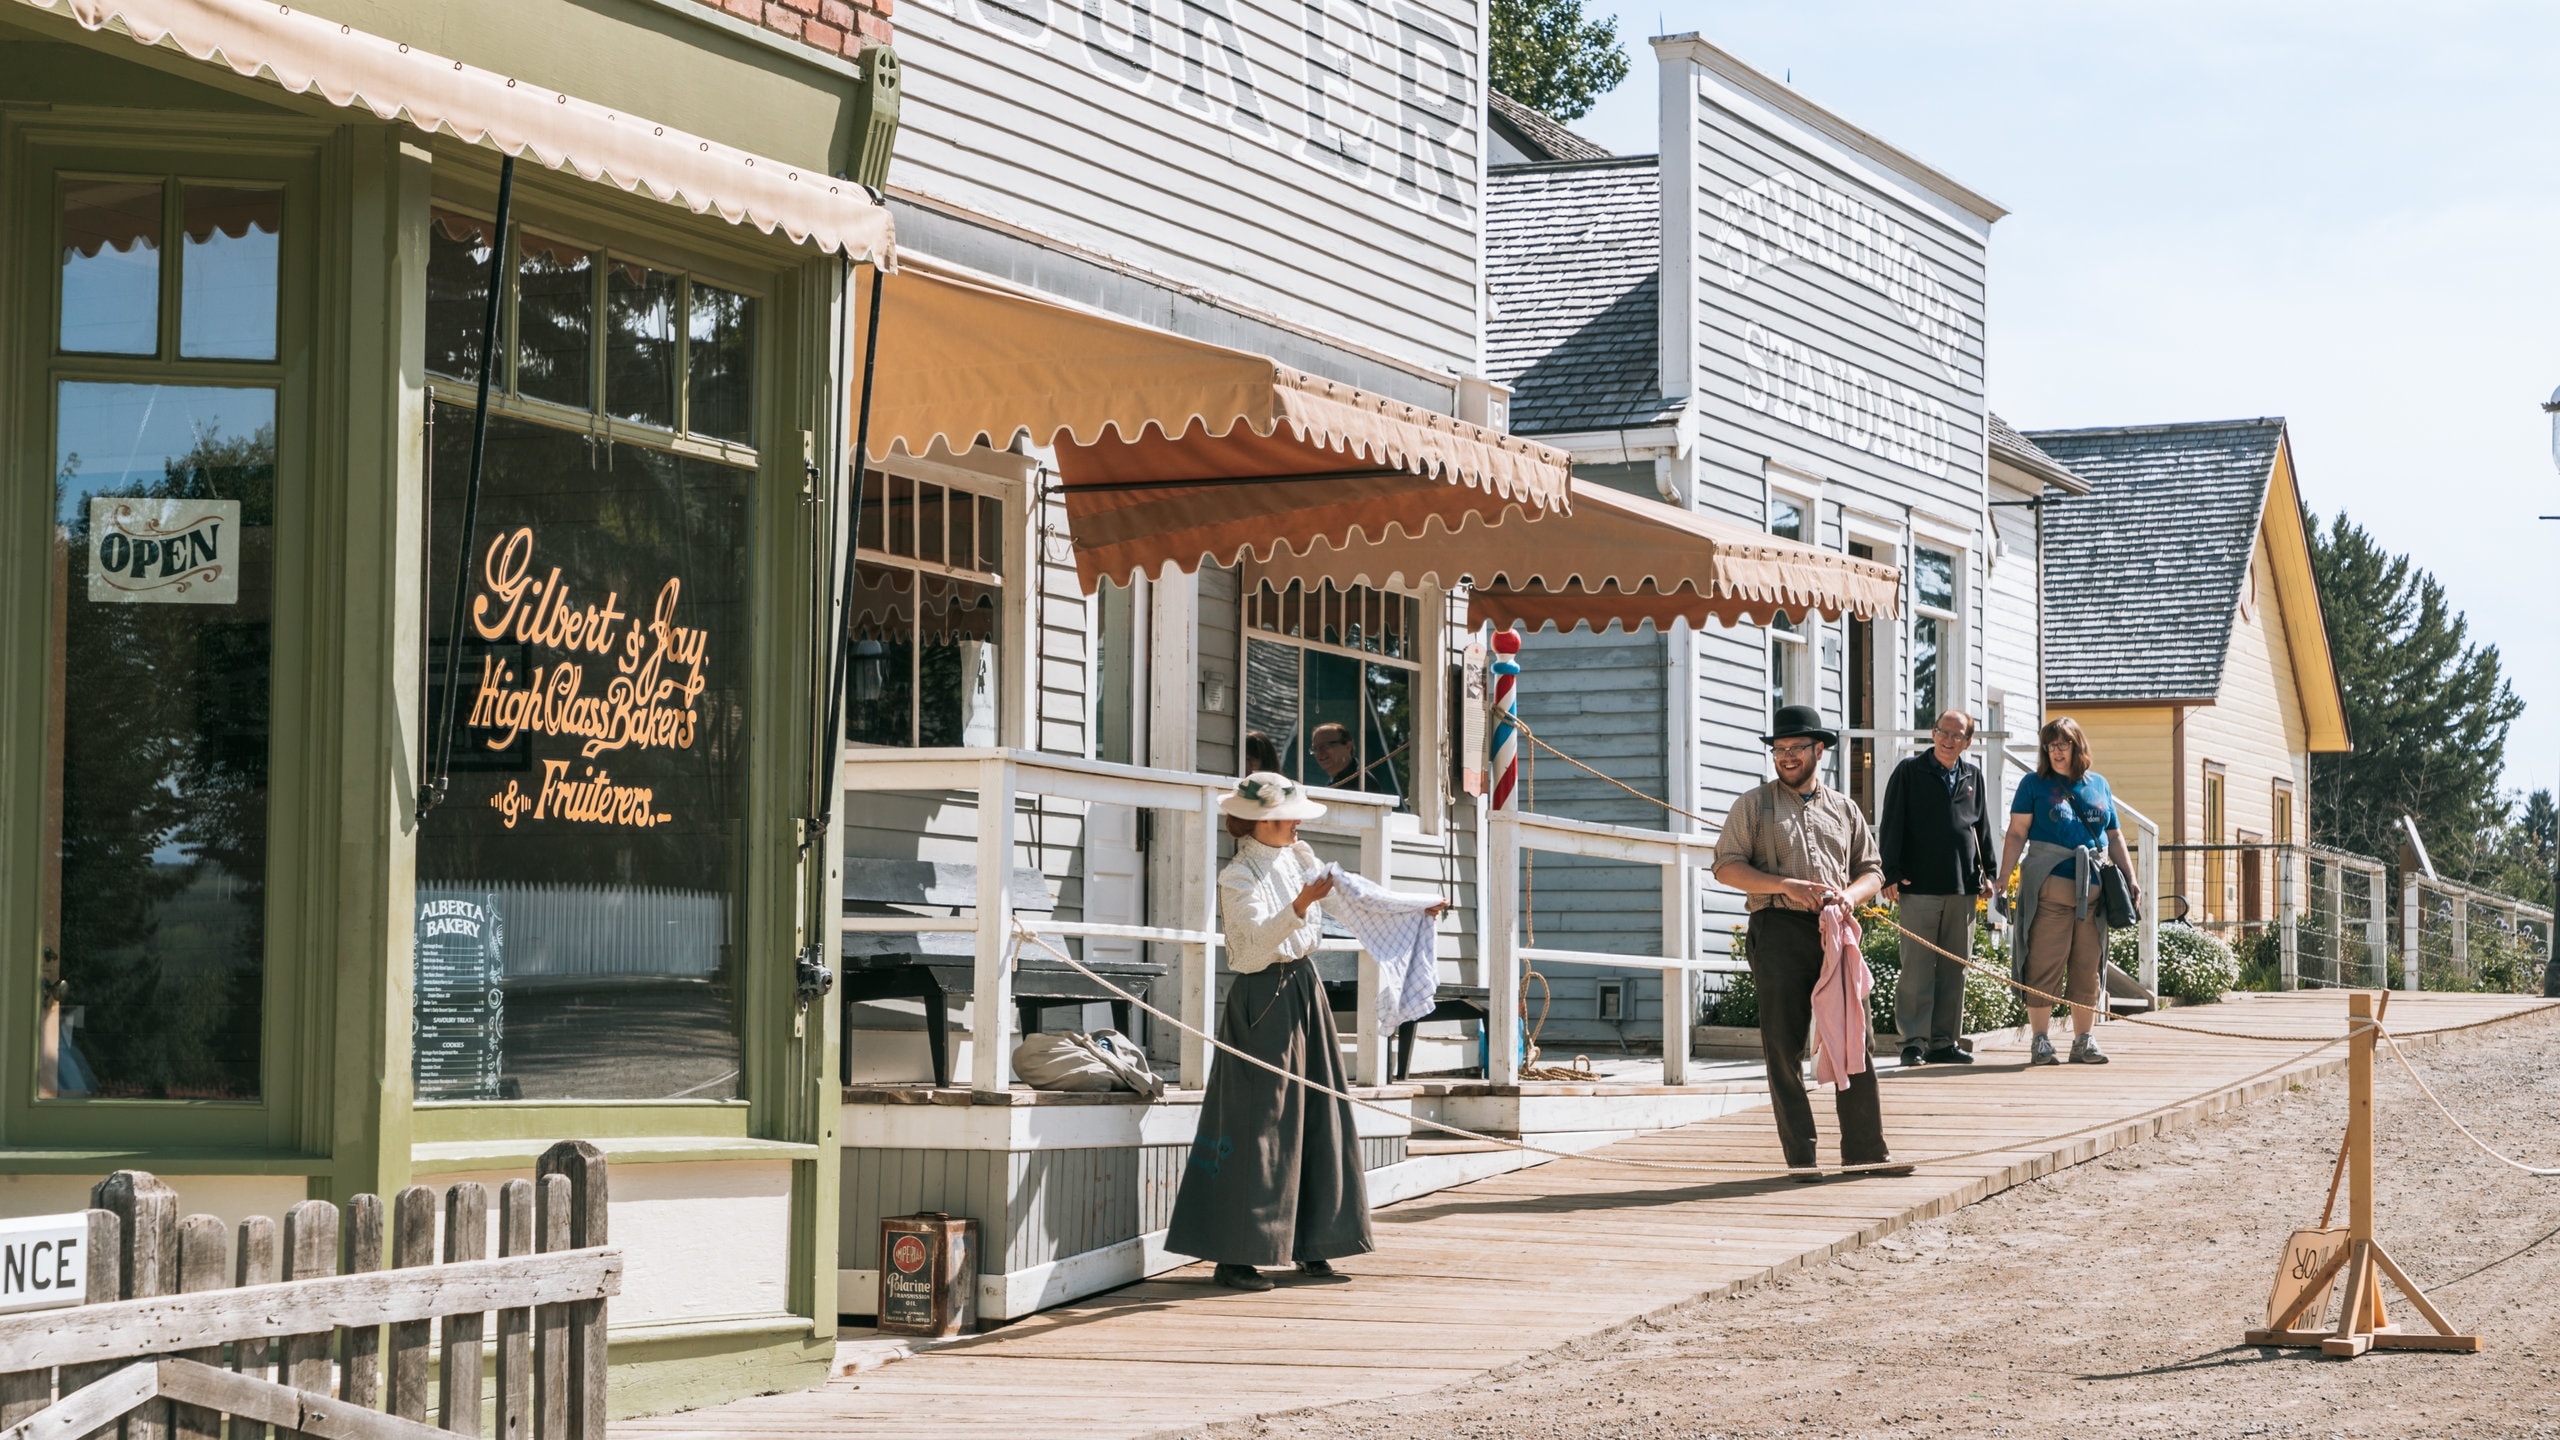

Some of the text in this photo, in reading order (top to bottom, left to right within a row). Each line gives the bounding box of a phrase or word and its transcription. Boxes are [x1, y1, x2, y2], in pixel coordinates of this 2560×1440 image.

[1712, 170, 1967, 391] STRATHMORE
[1744, 320, 1951, 480] STANDARD
[100, 523, 220, 578] OPEN
[473, 527, 625, 655] Gilbert
[468, 654, 698, 759] High Class Bakers
[420, 899, 485, 922] ALBERTA
[426, 917, 481, 938] BAKERY
[442, 1041, 465, 1049] COOKIES
[895, 1245, 923, 1264] IMPERIAL
[887, 1272, 931, 1298] Polarine
